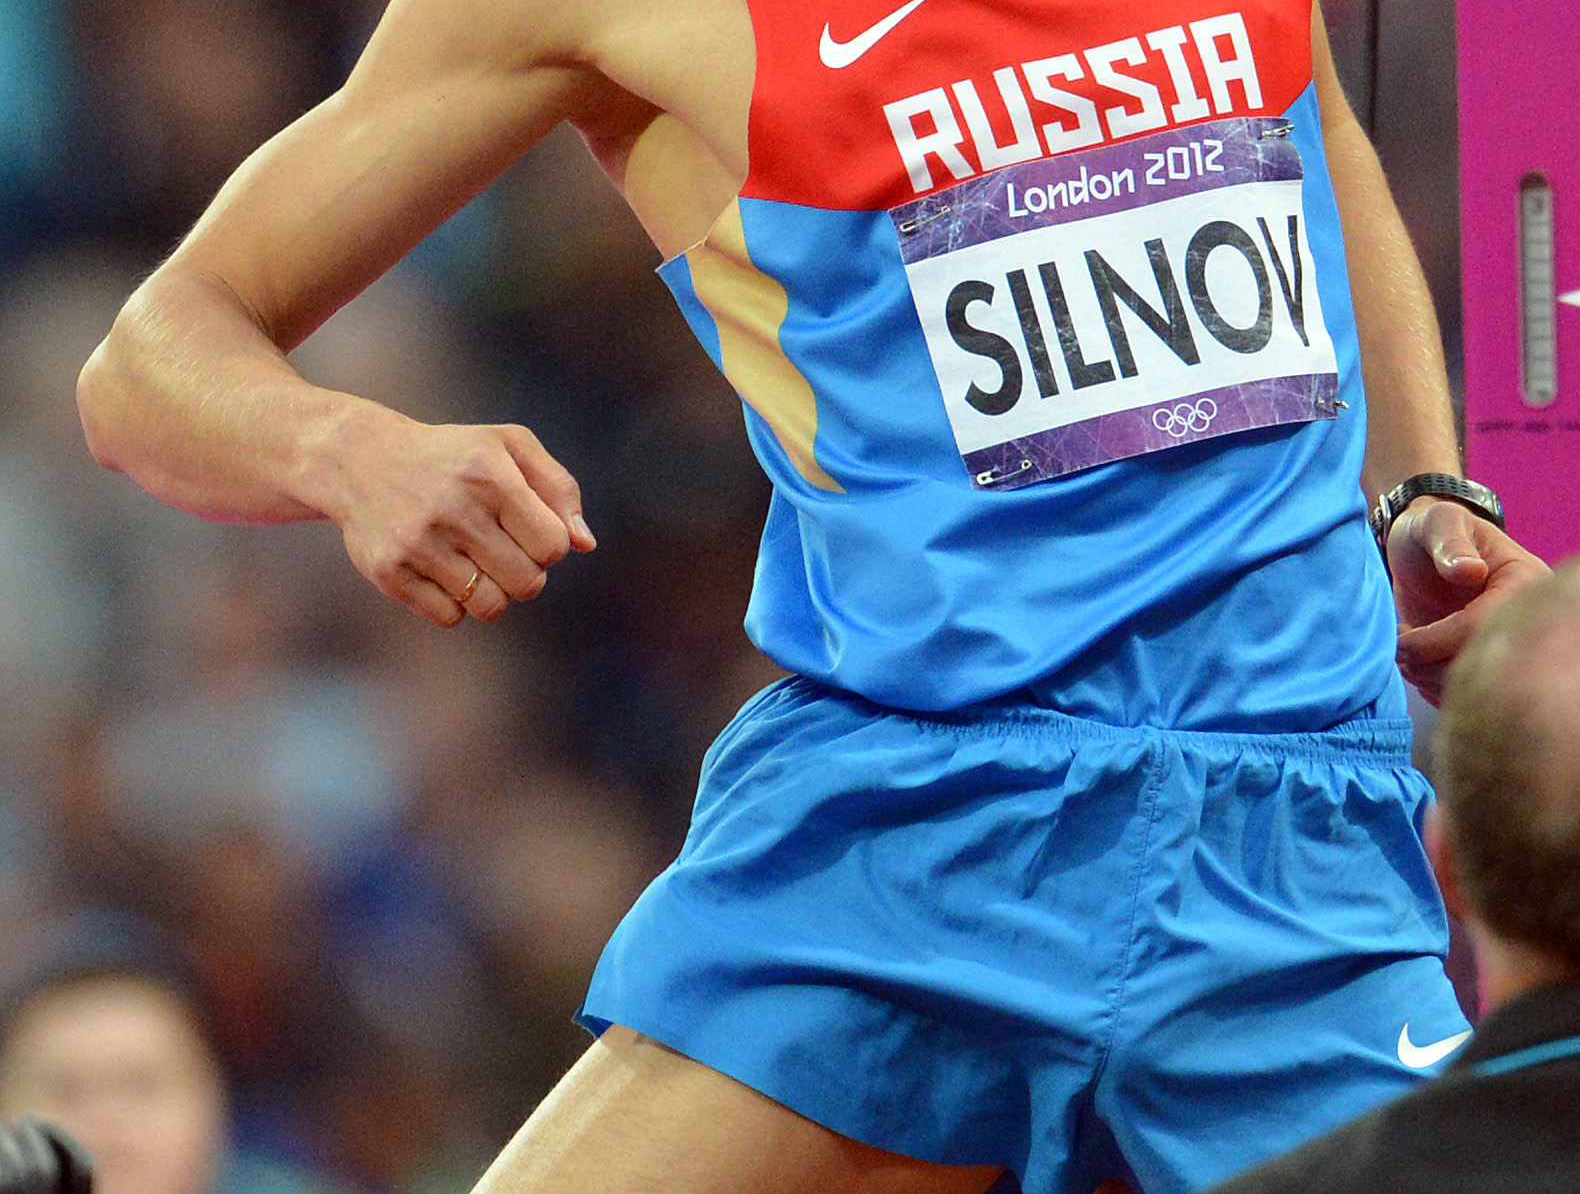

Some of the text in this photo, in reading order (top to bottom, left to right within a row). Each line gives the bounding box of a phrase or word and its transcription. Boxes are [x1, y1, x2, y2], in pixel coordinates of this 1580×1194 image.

[883, 12, 1264, 193] RUSSIA
[1007, 139, 1224, 218] London 2012
[945, 215, 1309, 416] SILNOV
